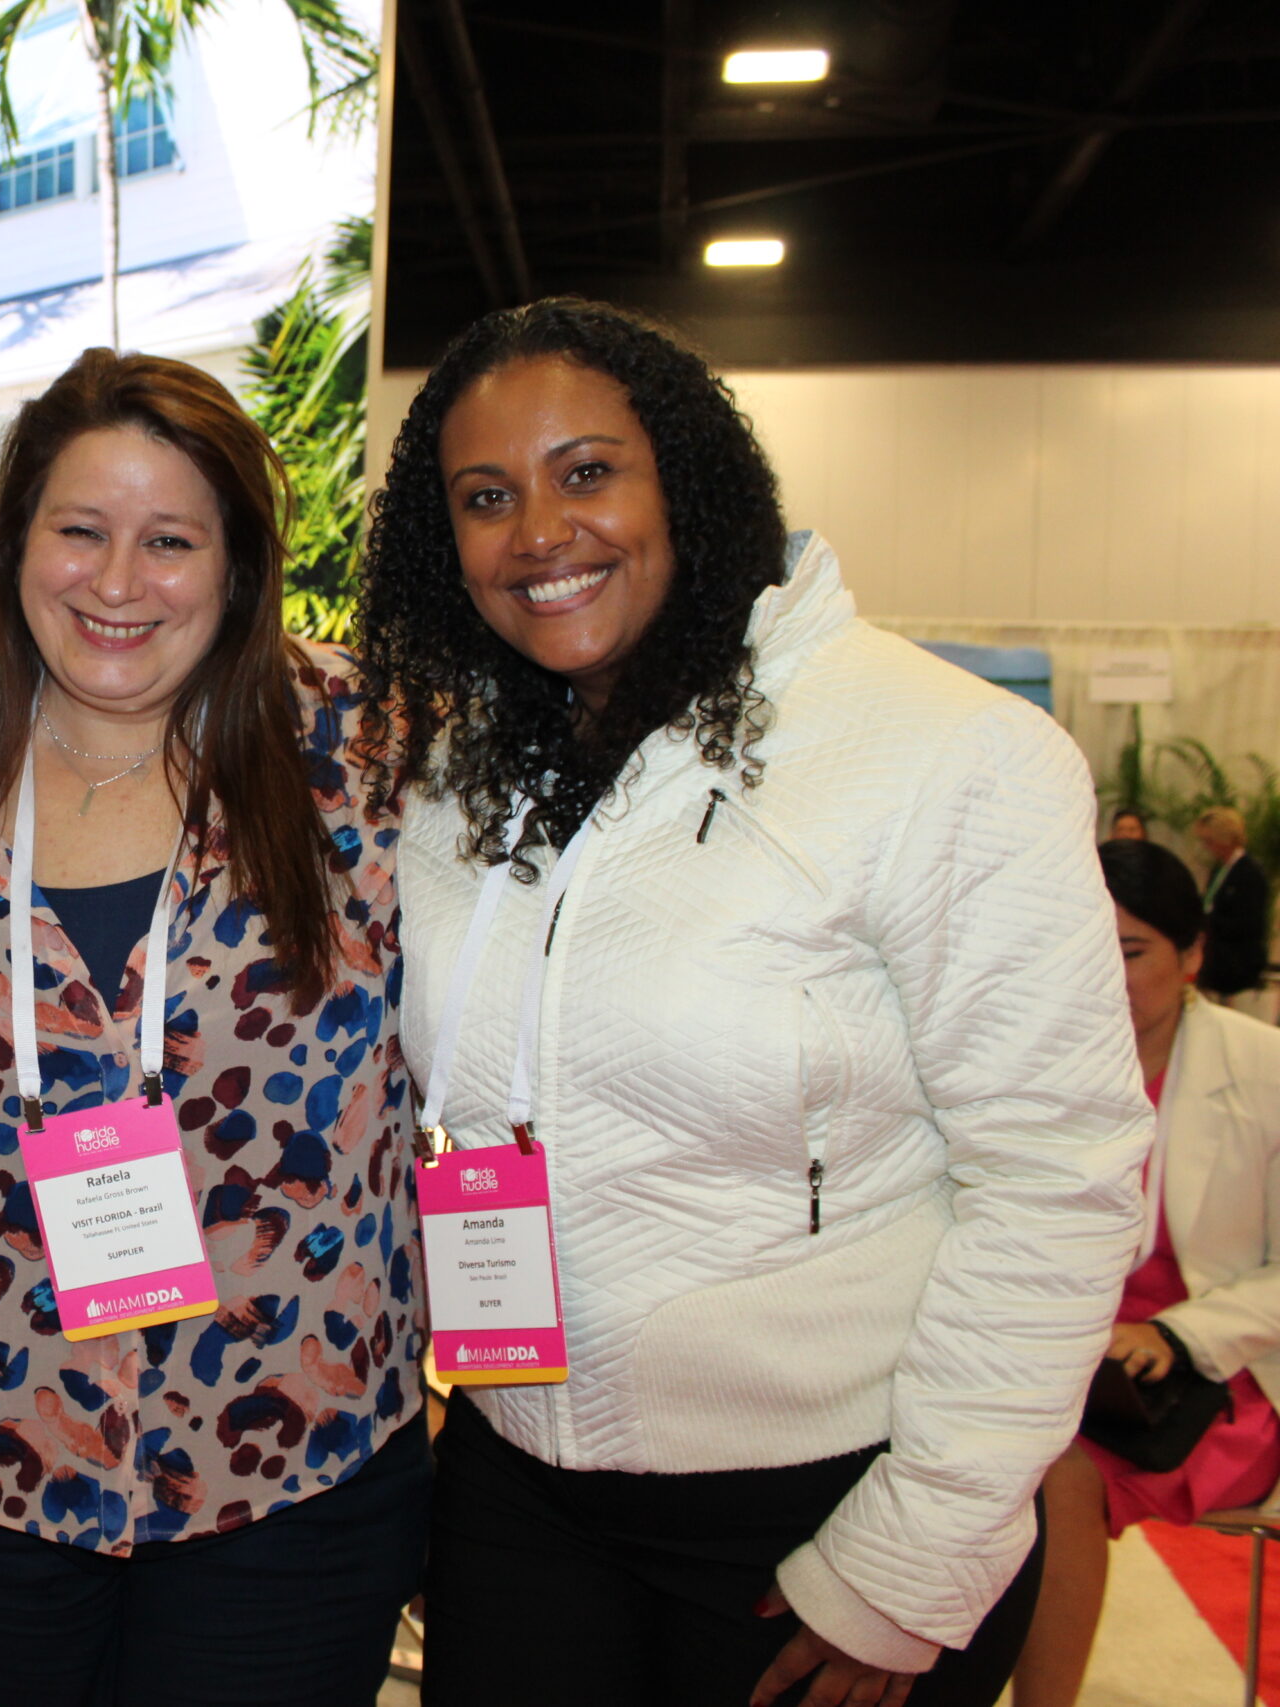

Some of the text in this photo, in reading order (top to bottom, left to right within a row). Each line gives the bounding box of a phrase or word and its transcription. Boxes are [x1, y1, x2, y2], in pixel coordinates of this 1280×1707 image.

[74, 1126, 116, 1142] florida
[76, 1135, 120, 1153] huddle
[86, 1170, 131, 1187] Rafaela
[461, 1178, 498, 1192] huddle
[76, 1185, 149, 1205] Rafaela Gross Brown
[72, 1218, 93, 1229] VISIT
[95, 1210, 133, 1224] FLORIDA
[139, 1202, 163, 1215] Brazil
[463, 1217, 504, 1230] Amanda
[464, 1237, 490, 1246] Amanda
[107, 1246, 144, 1260] SUPPLIER
[458, 1259, 516, 1269] Diversa Turismo
[480, 1299, 501, 1308] BUYER
